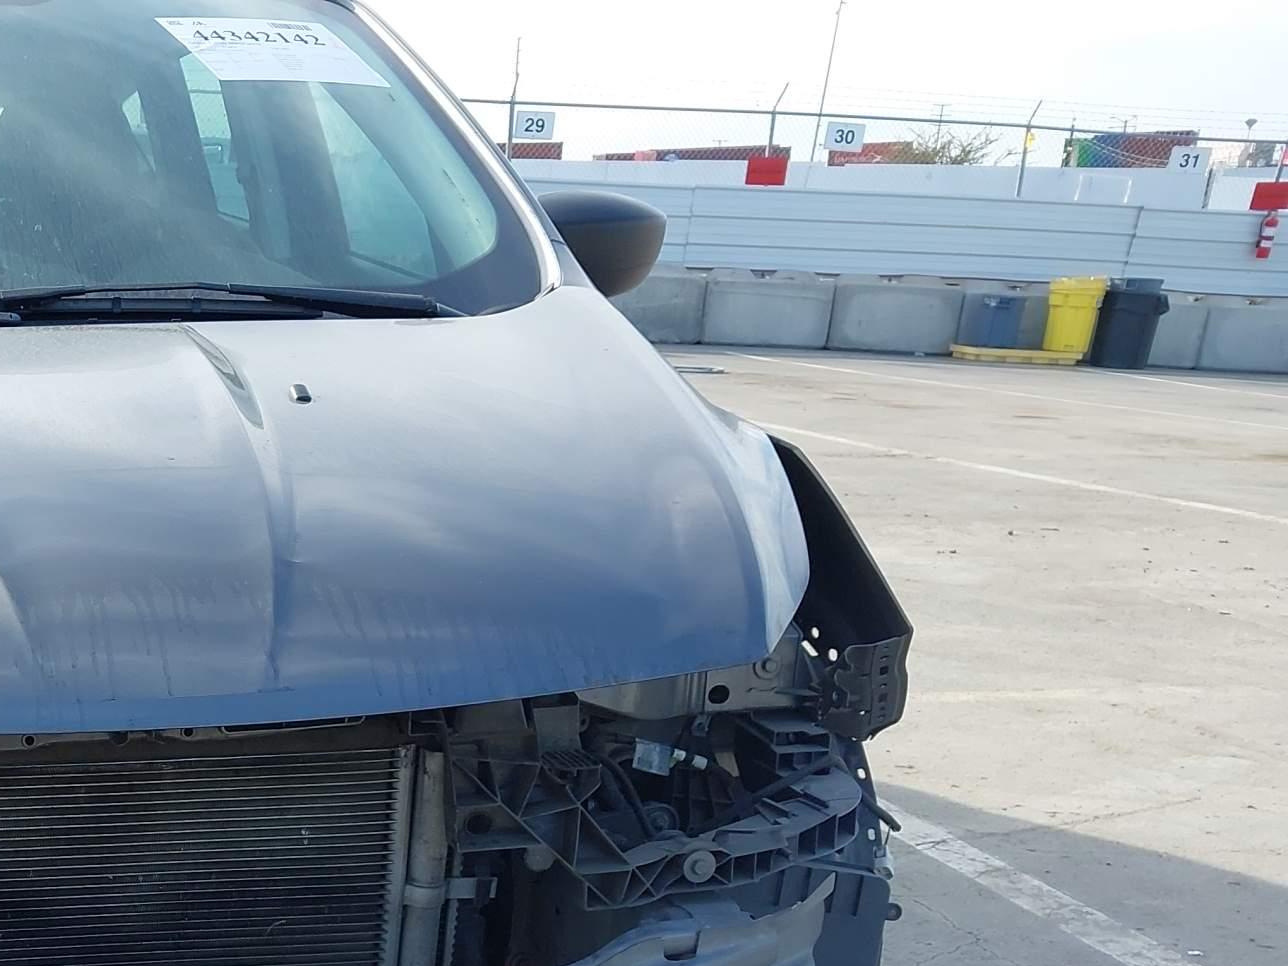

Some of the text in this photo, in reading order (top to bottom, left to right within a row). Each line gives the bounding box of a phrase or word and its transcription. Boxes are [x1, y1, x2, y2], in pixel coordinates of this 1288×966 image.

[192, 29, 326, 46] 44342142
[524, 117, 545, 133] 29
[834, 129, 855, 144] 30
[1179, 153, 1200, 169] 31
